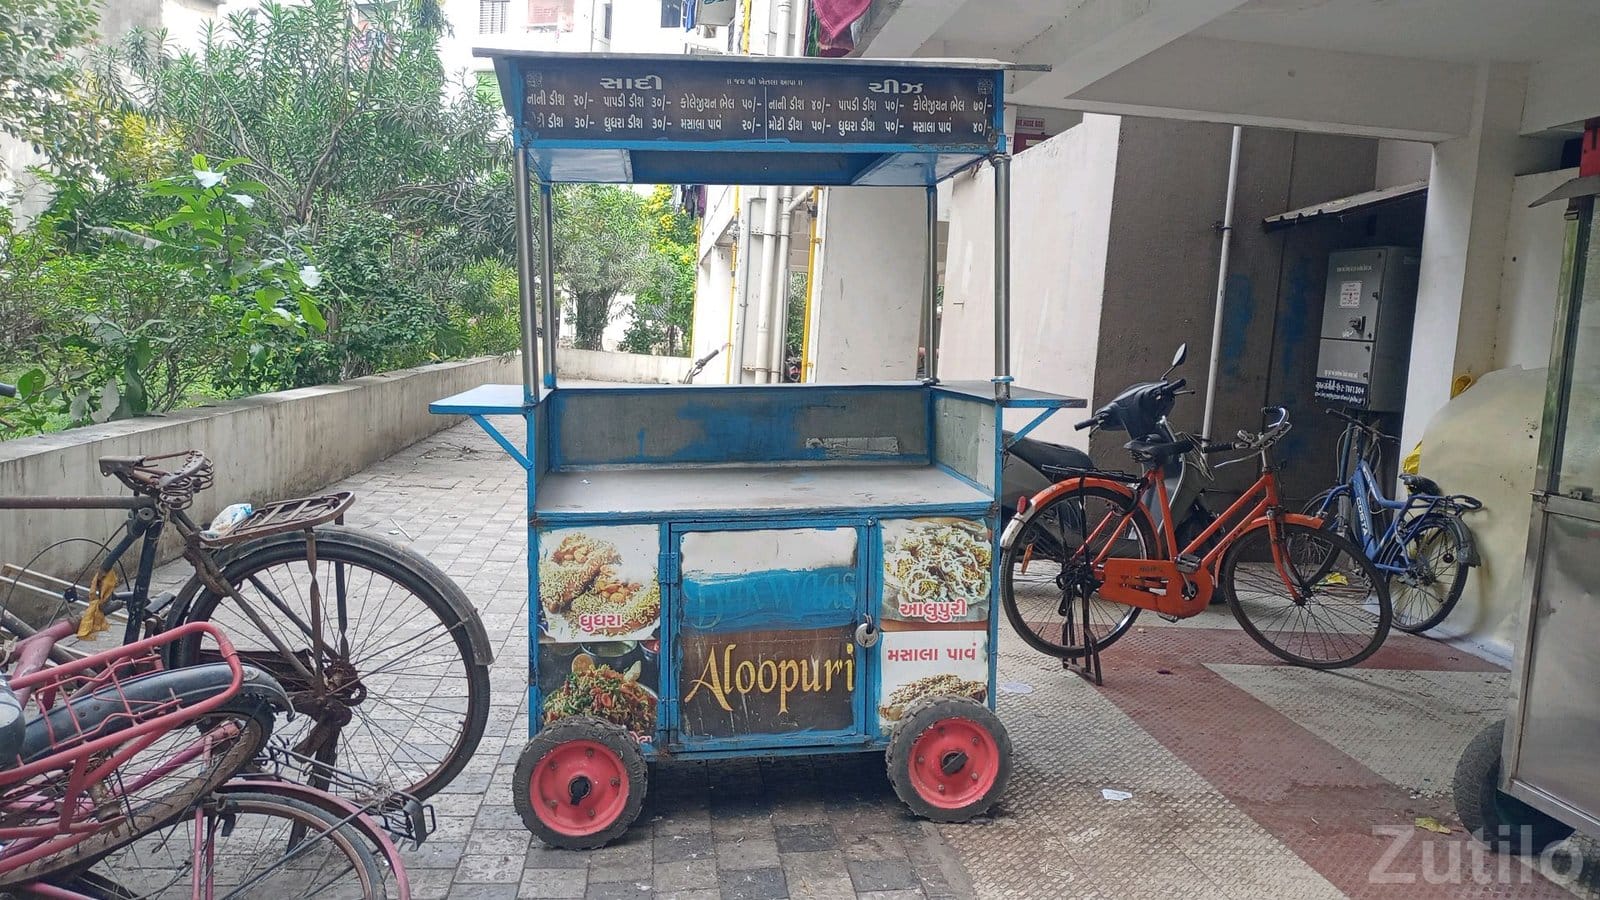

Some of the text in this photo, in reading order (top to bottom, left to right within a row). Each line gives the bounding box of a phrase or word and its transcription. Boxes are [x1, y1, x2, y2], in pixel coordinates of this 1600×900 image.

[600, 75, 662, 90] સાદી
[868, 79, 924, 94] ચીઝ
[527, 90, 546, 105] નાની
[549, 90, 565, 106] ડીશ
[603, 93, 626, 107] પાપડી
[629, 93, 644, 107] ડીશ
[680, 93, 717, 112] કોલેજીયન
[720, 94, 735, 109] ભેલ
[768, 96, 787, 110] નાની
[789, 96, 805, 110] ડીશ
[838, 96, 859, 111] પાપડી
[862, 96, 877, 111] ડીશ
[912, 95, 948, 115] કોલેજીયન
[950, 95, 965, 112] ભેલ
[548, 112, 564, 128] ડીશ
[628, 114, 643, 128] ડીશ
[681, 118, 705, 130] મસાલા
[768, 115, 785, 131] મોટી
[788, 116, 803, 131] ડીશ
[861, 117, 876, 132] ડીશ
[912, 121, 936, 133] મસાલા
[899, 598, 968, 622] આલુપુરી
[887, 648, 938, 661] મસાલા
[684, 643, 855, 716] Aloopuri
